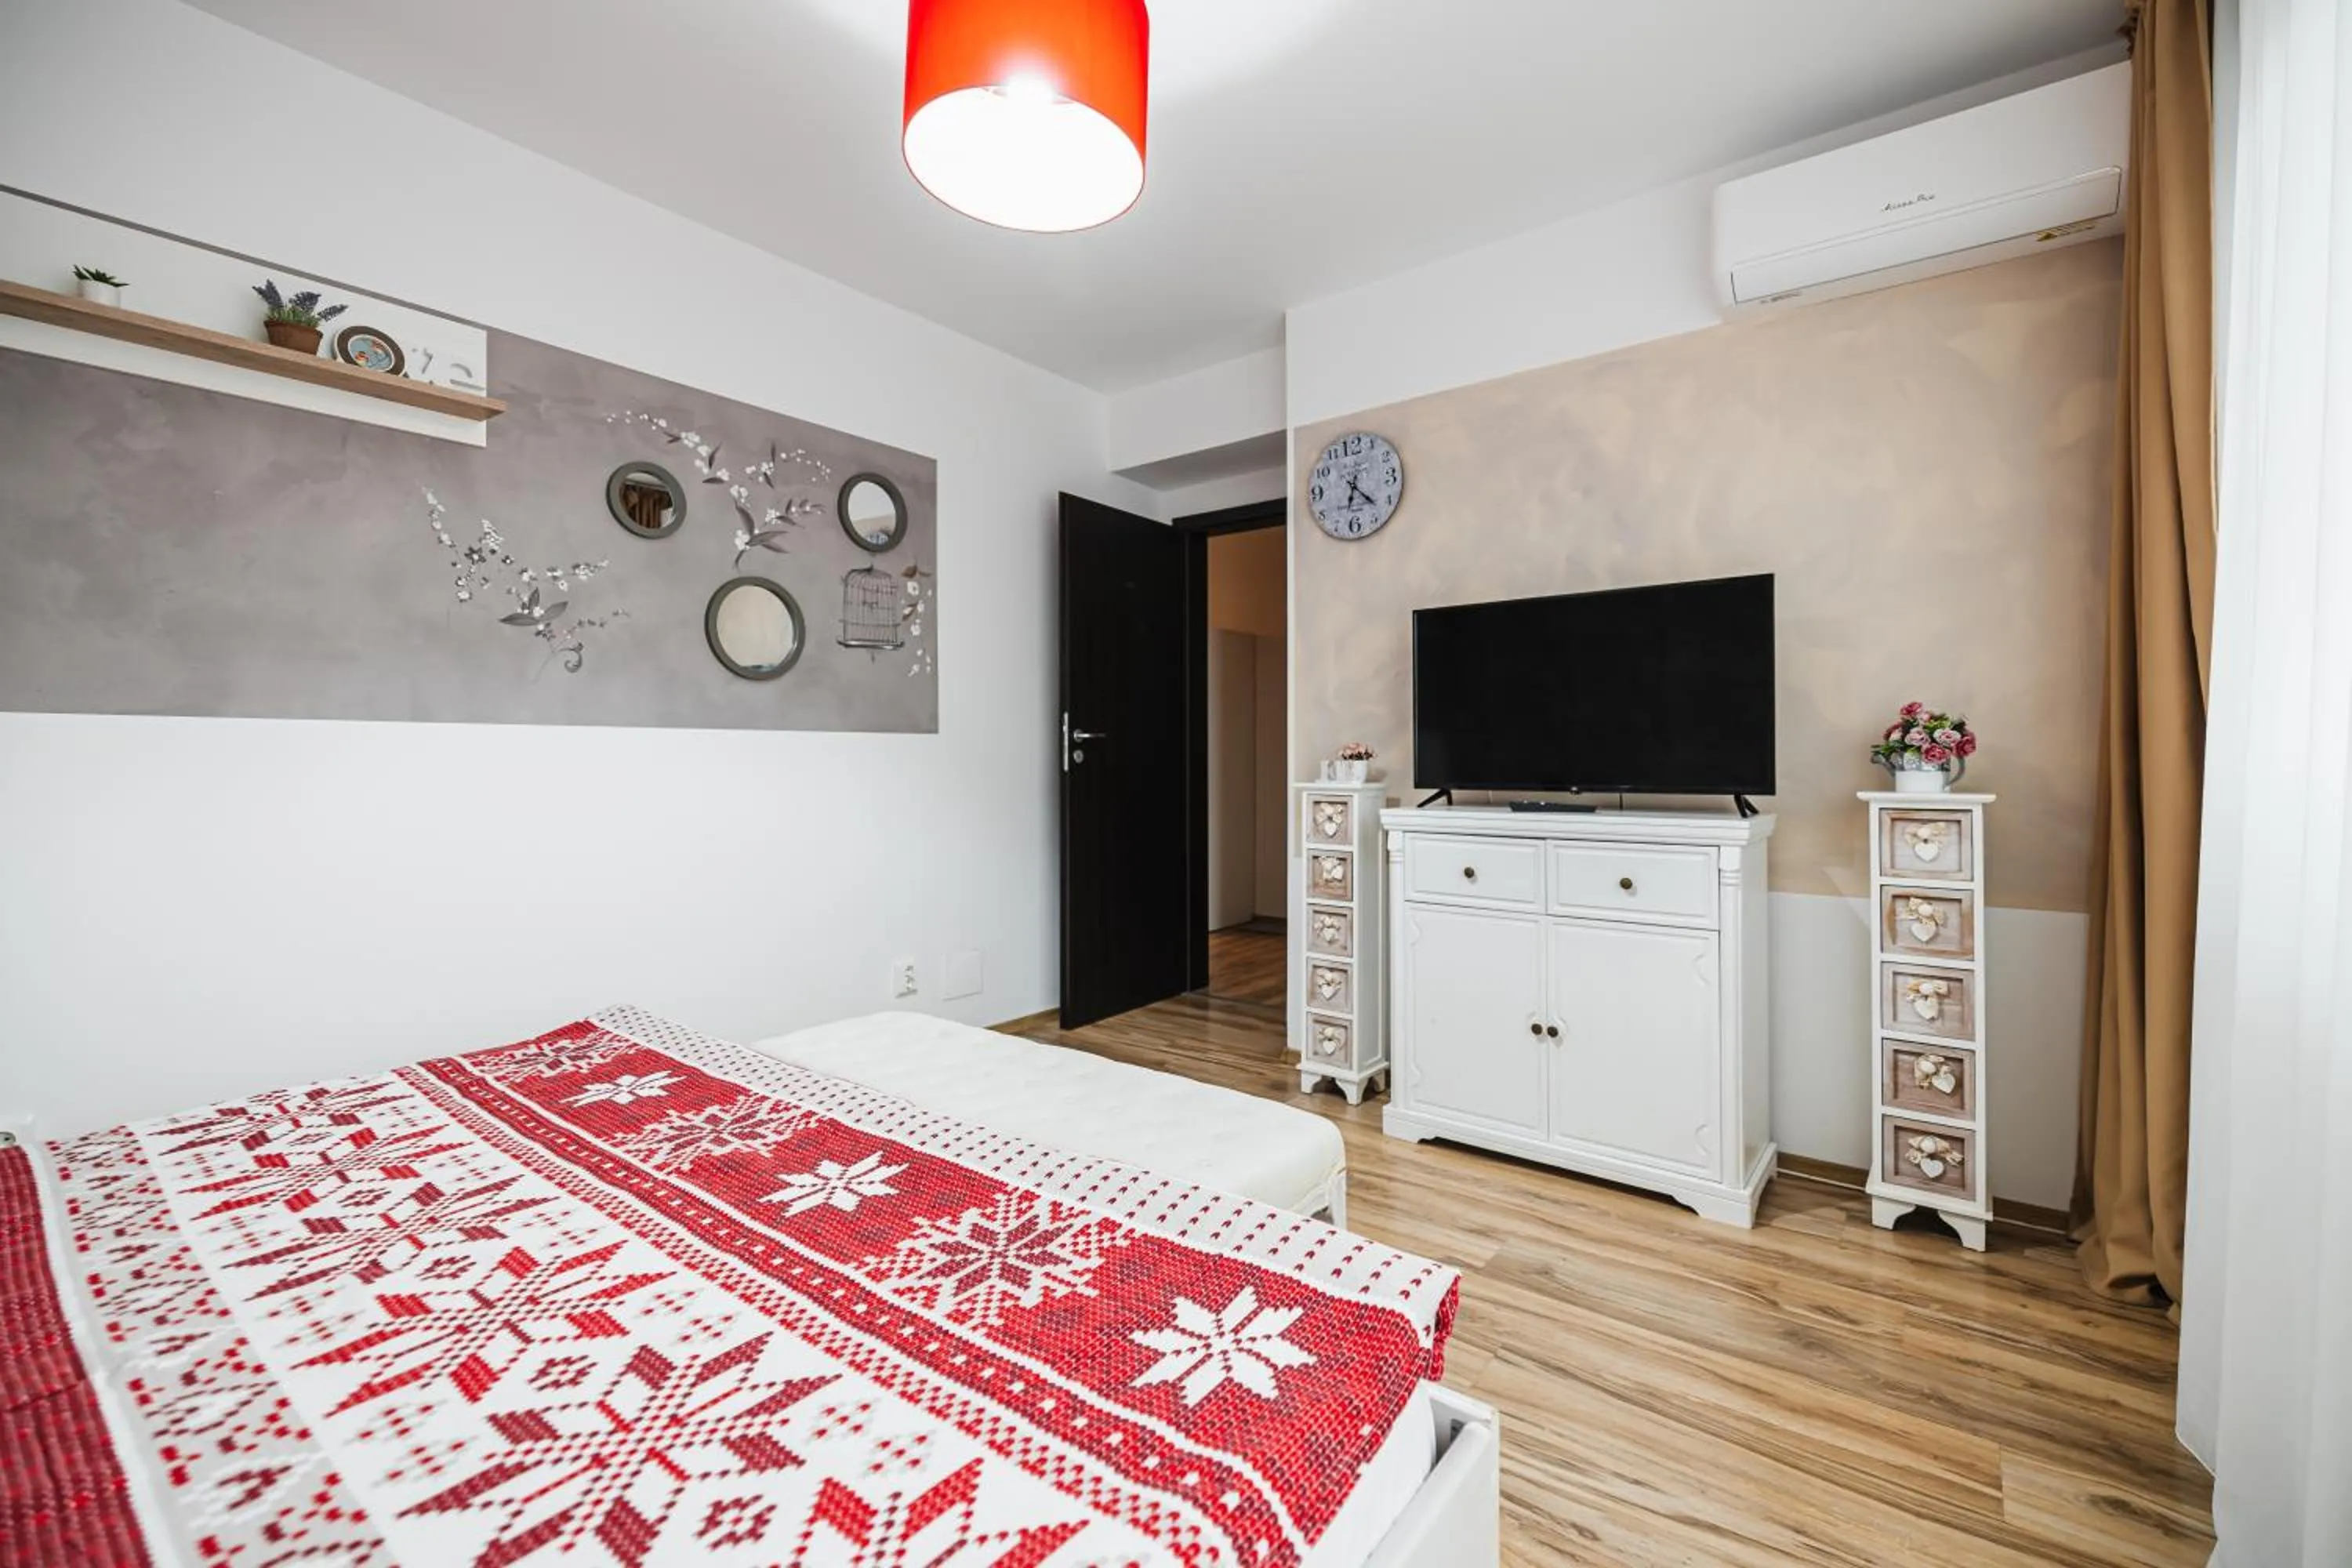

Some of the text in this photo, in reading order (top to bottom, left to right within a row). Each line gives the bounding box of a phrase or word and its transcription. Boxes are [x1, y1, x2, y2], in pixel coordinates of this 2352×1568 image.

[1328, 448, 1338, 460] 11
[1342, 437, 1362, 457] 12
[1316, 466, 1330, 478] 10
[1385, 467, 1396, 487] 3
[1311, 485, 1323, 502] 9
[1348, 515, 1361, 533] 6
